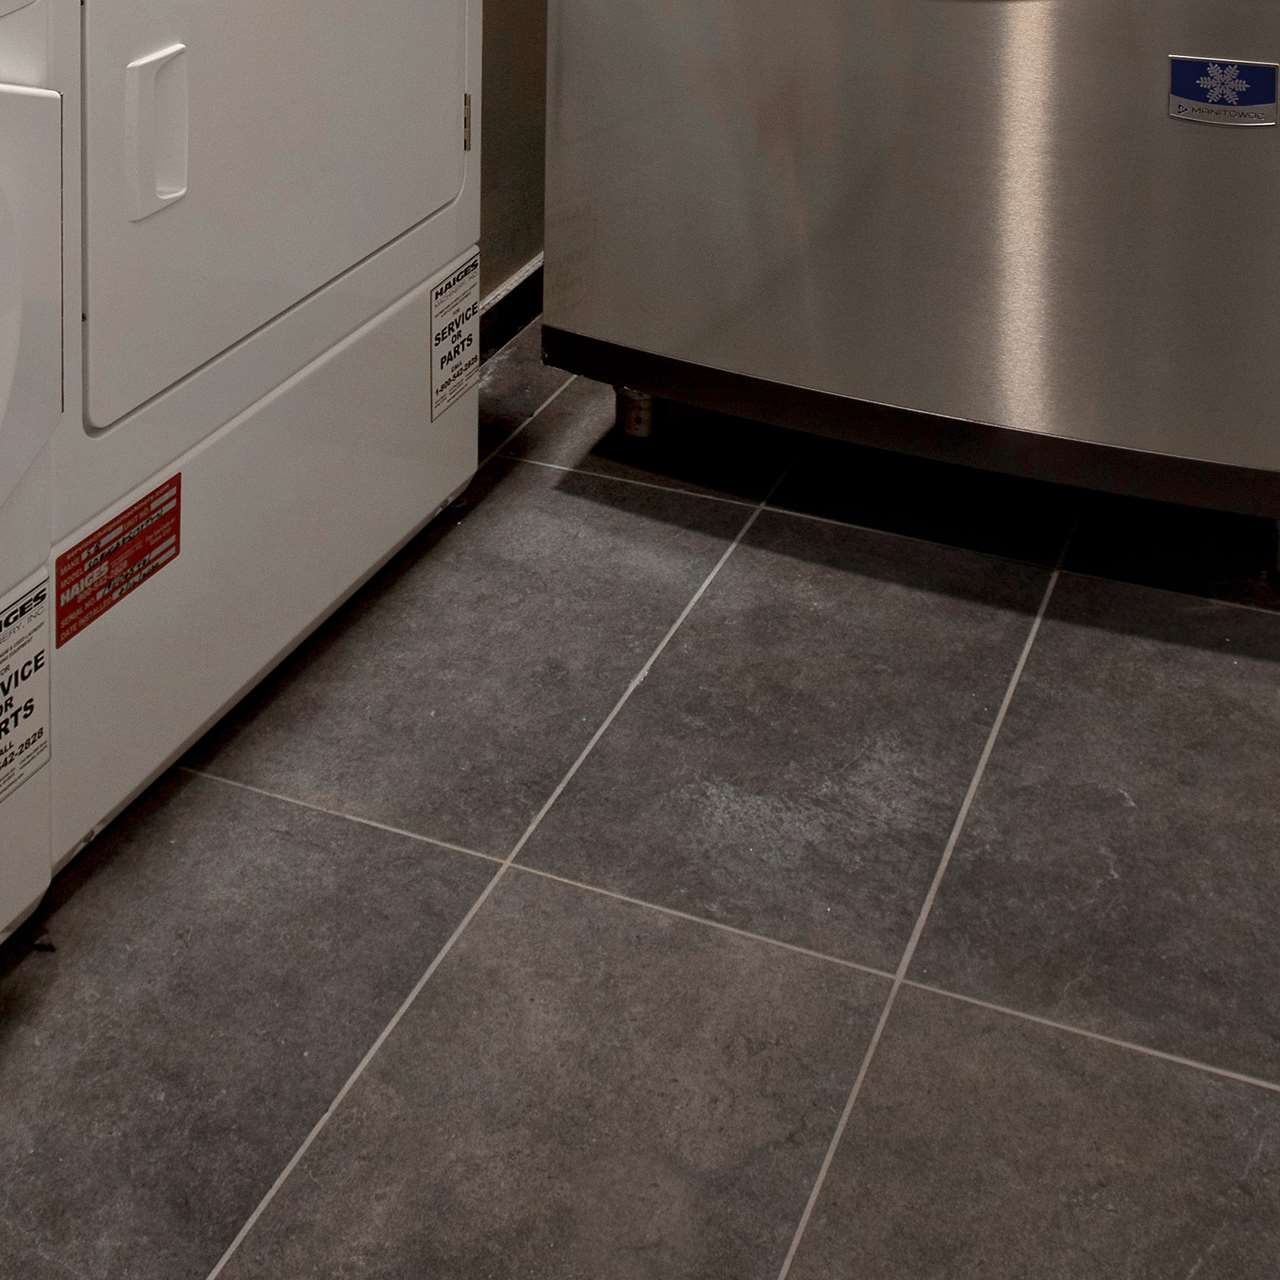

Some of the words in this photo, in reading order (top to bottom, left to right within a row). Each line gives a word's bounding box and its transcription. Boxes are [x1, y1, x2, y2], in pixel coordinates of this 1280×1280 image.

[435, 259, 479, 300] HAIGES
[434, 302, 478, 347] SERVICE
[451, 330, 462, 345] OR
[440, 333, 473, 371] PARTS
[60, 561, 109, 608] HAIGES
